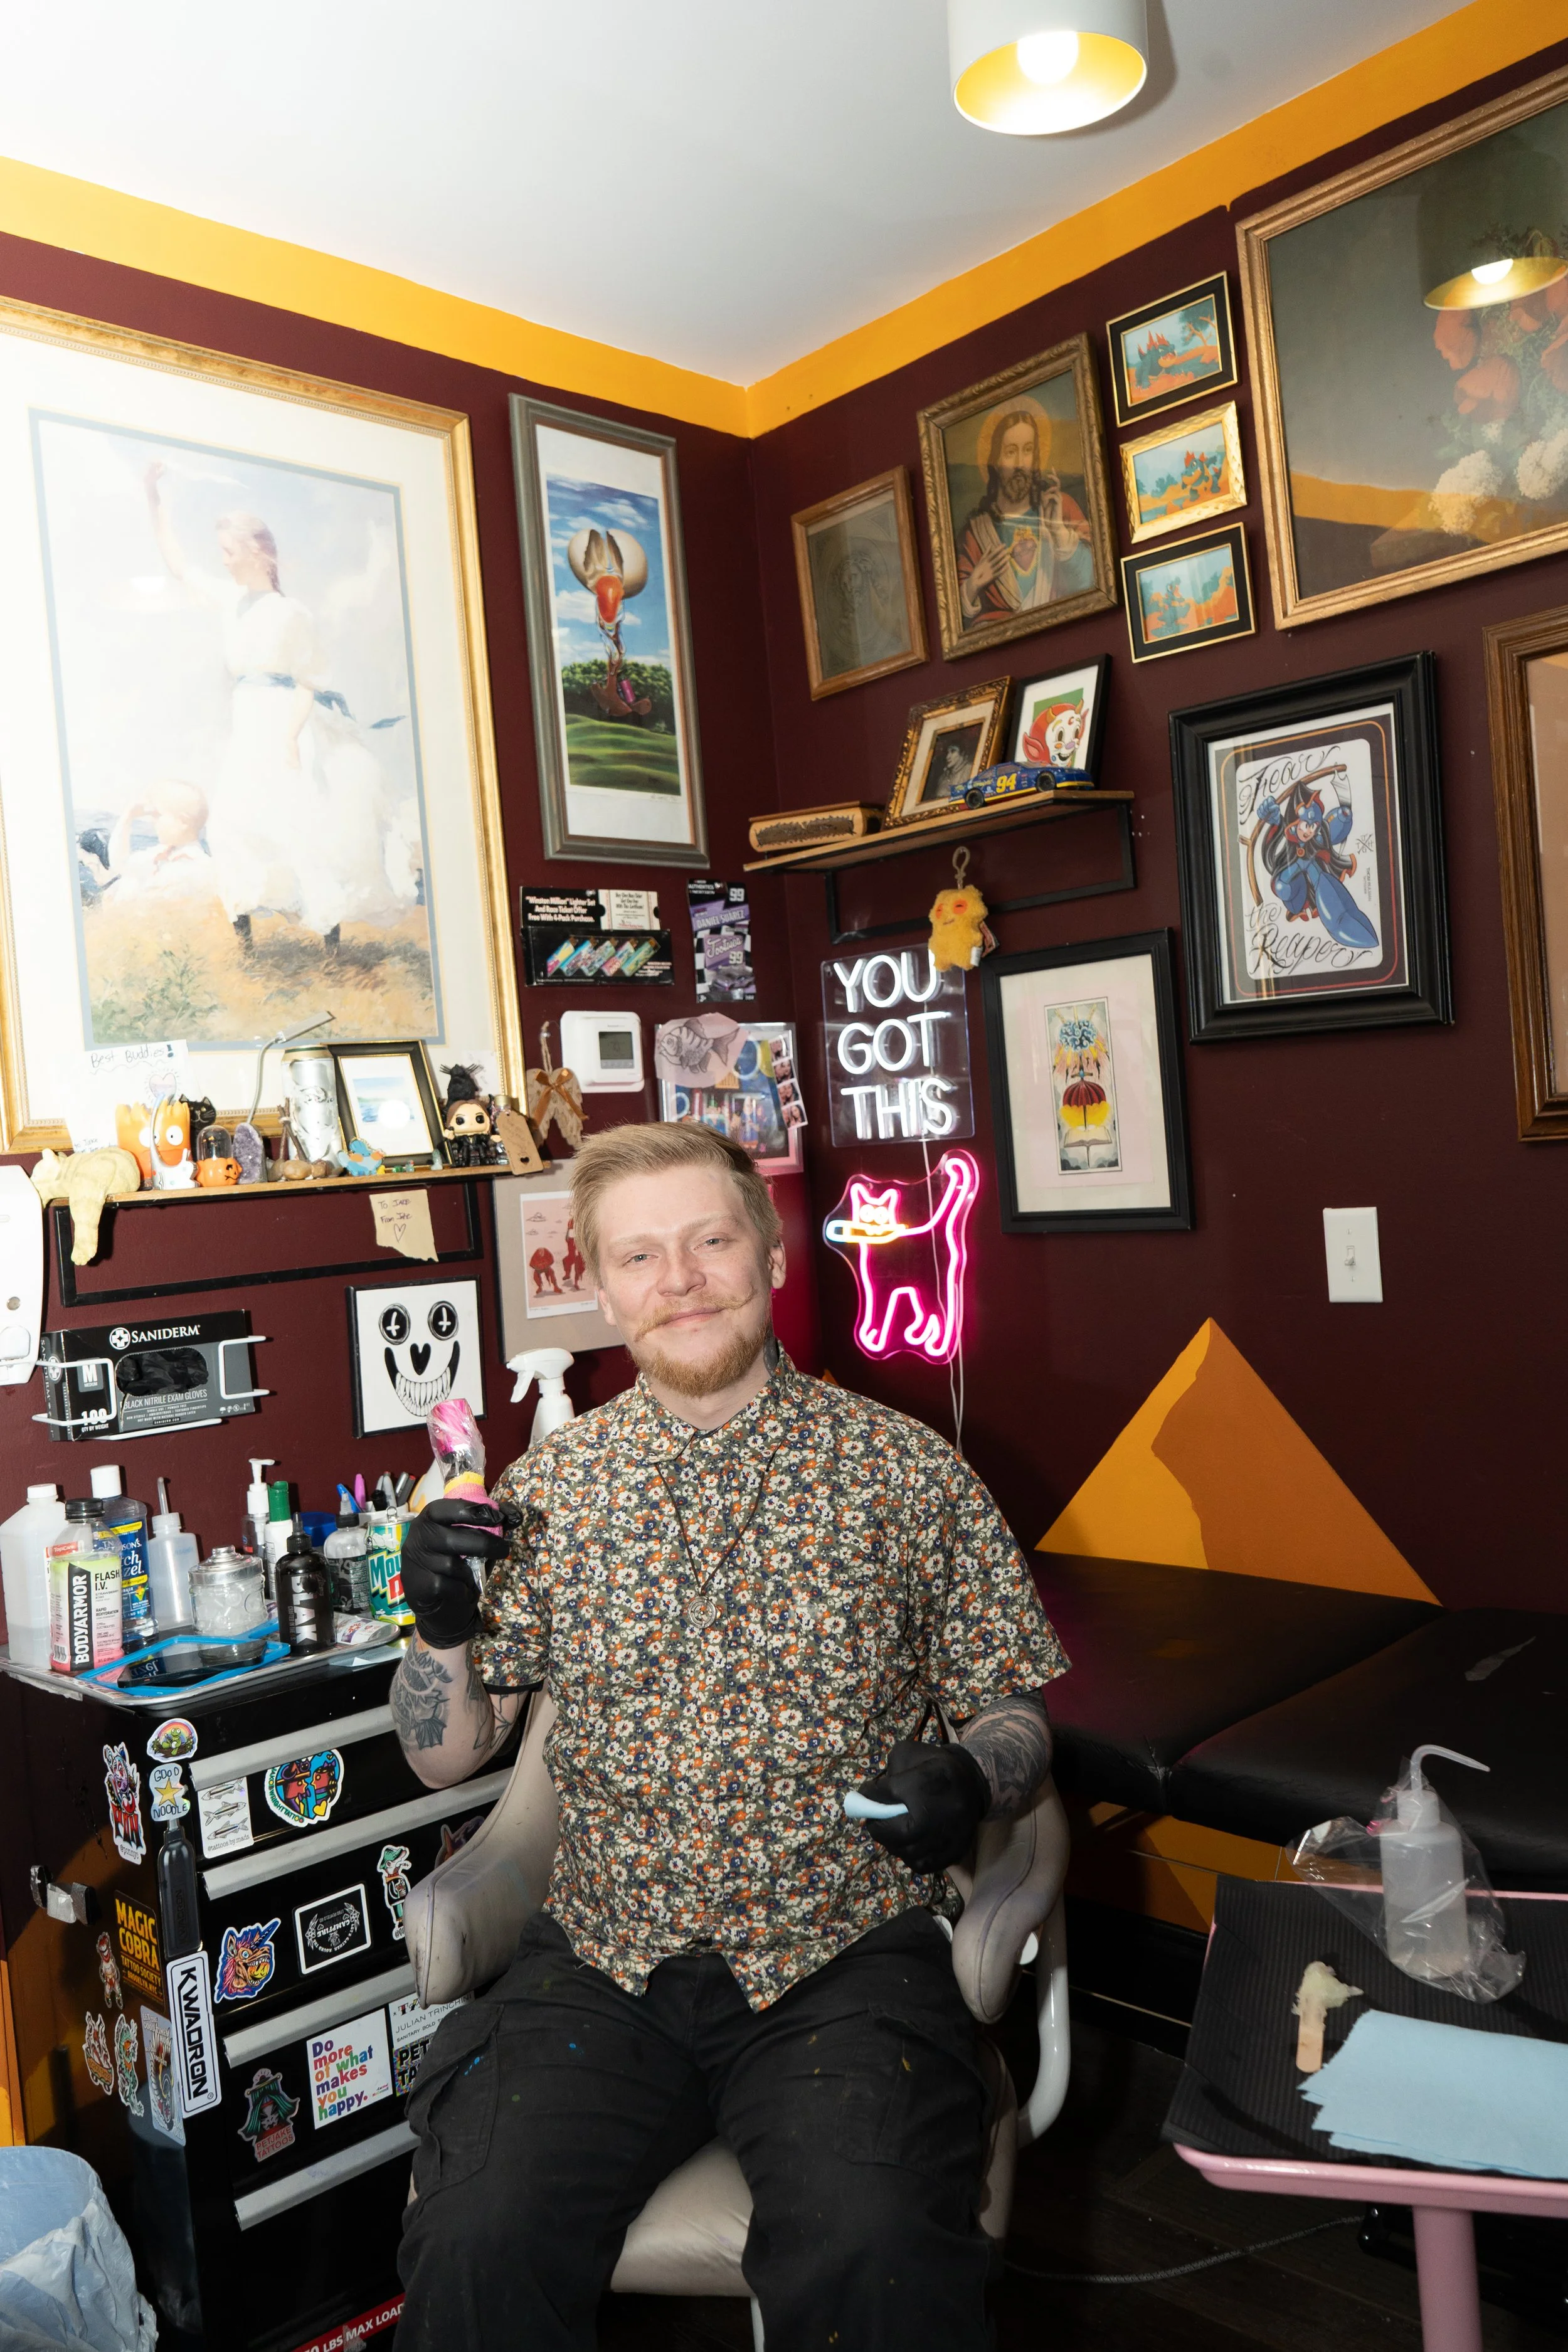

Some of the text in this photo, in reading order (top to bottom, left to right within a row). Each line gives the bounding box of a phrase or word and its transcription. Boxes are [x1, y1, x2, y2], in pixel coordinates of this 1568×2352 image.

[995, 773, 1017, 793] 94
[569, 897, 587, 906] Lighter
[587, 898, 596, 906] Set
[729, 887, 744, 902] 99
[528, 913, 540, 921] Free
[534, 904, 546, 913] And
[559, 904, 573, 913] Ticket
[573, 905, 587, 914] Offer
[697, 916, 721, 929] DANIEL
[729, 951, 744, 964] 99
[833, 949, 938, 1013] YOU
[837, 1010, 950, 1075] GOT
[91, 1051, 115, 1068] Best
[840, 1077, 955, 1140] THIS
[131, 1325, 199, 1343] SANIDERM
[41, 1339, 50, 1399] SANDERM
[82, 1364, 98, 1383] M
[124, 1389, 208, 1409] BLACK NITRILE EXAM GLOVES
[81, 1408, 108, 1426] 100
[121, 1550, 139, 1567] tch
[124, 1560, 144, 1577] zel.
[95, 1569, 120, 1582] FLASH
[95, 1581, 108, 1591] I.V.
[72, 1574, 90, 1665] BODYARMOR
[153, 1803, 188, 1819] NOODLE
[208, 1834, 250, 1851] @tattoos.by.mads
[115, 1898, 157, 1945] MAGIC
[317, 1919, 350, 1937] CAMPFIRE
[119, 1927, 160, 1972] COBRA
[121, 1954, 161, 1987] TATTOO SOCIETY
[177, 1966, 209, 2100] KWADRON
[396, 2014, 426, 2033] JULIAN
[397, 2021, 436, 2042] SANITARY BOLD
[312, 2040, 334, 2058] Do
[314, 2045, 352, 2070] more
[315, 2045, 373, 2082] of what
[316, 2064, 368, 2095] makes
[317, 2086, 347, 2109] you
[318, 2090, 368, 2121] happy.
[256, 2126, 292, 2150] PETJAKE
[257, 2135, 294, 2158] TATTOOS
[323, 2335, 343, 2352] LBS
[346, 2319, 373, 2341] MAX
